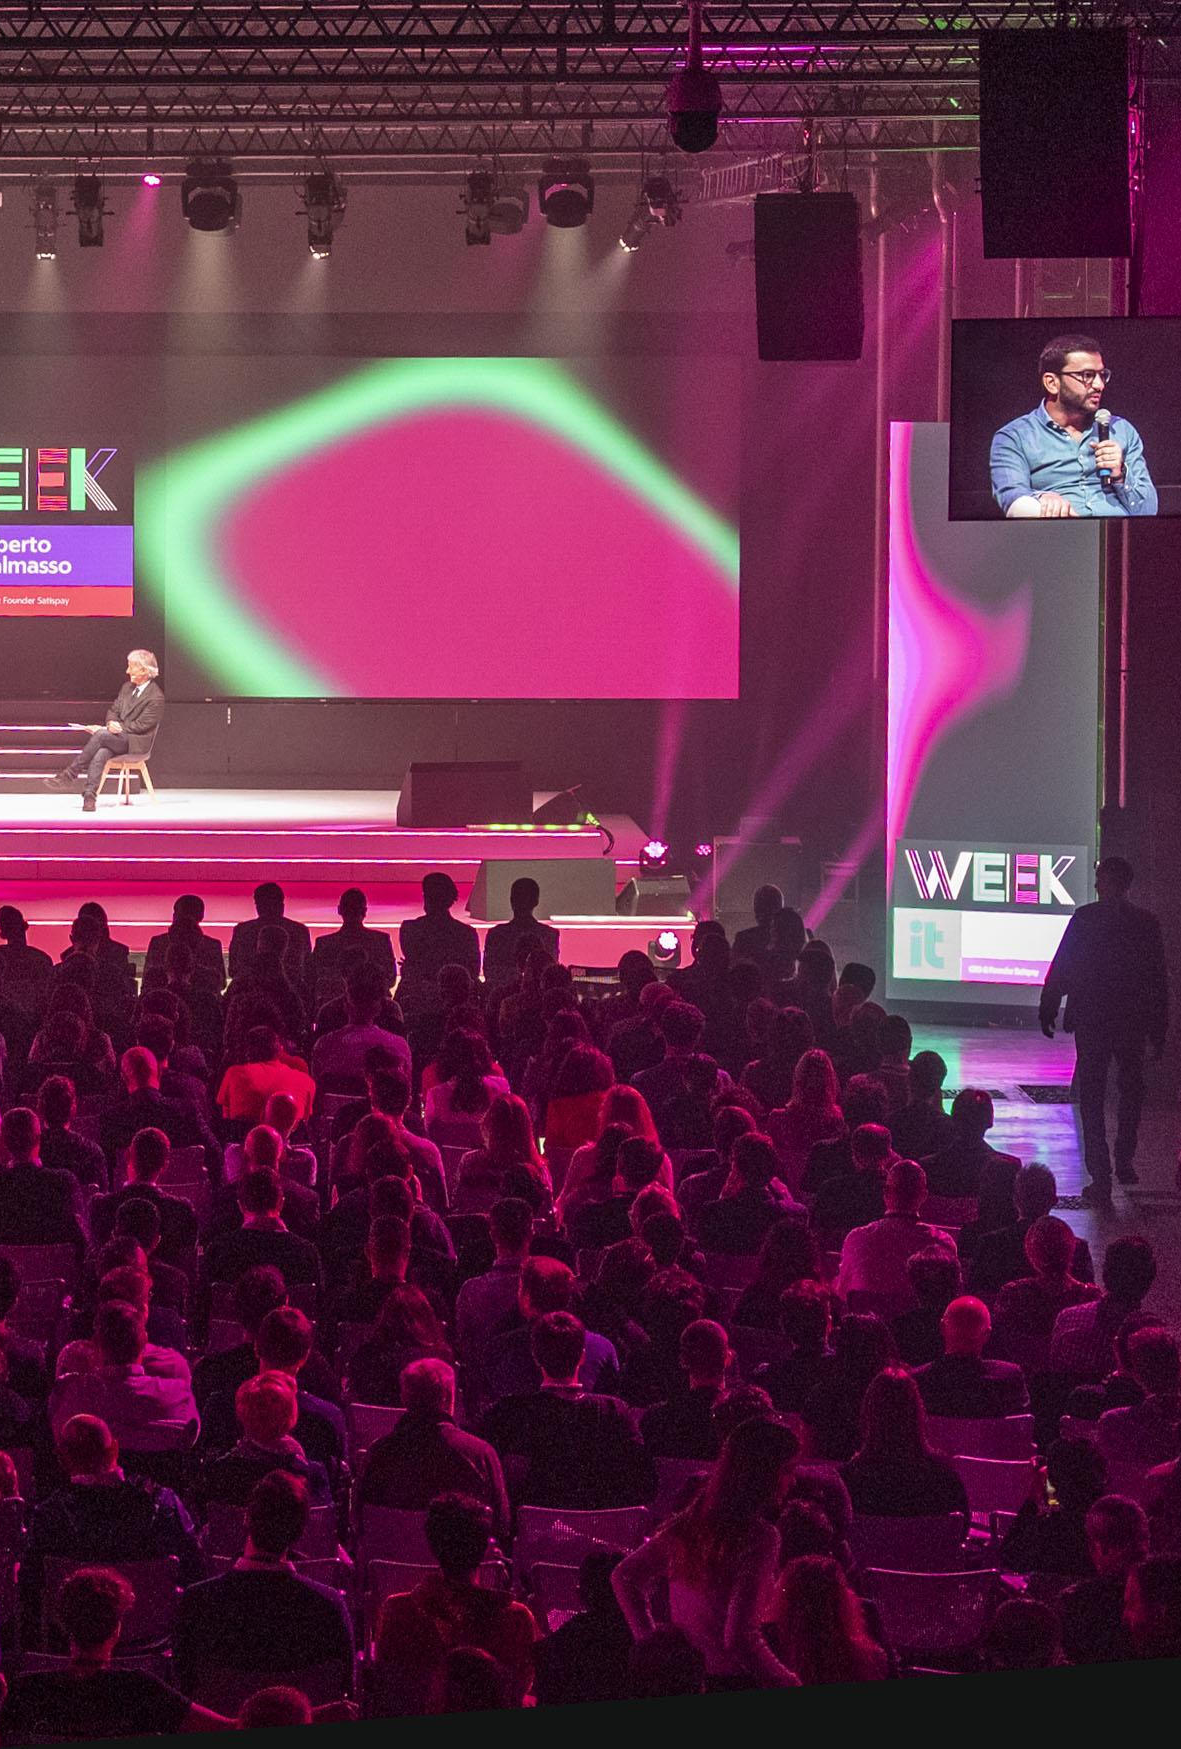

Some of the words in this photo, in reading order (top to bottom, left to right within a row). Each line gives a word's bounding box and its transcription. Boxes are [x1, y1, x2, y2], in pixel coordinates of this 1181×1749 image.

[2, 595, 36, 606] Founder
[905, 849, 1076, 906] WEEK
[910, 919, 946, 970] it
